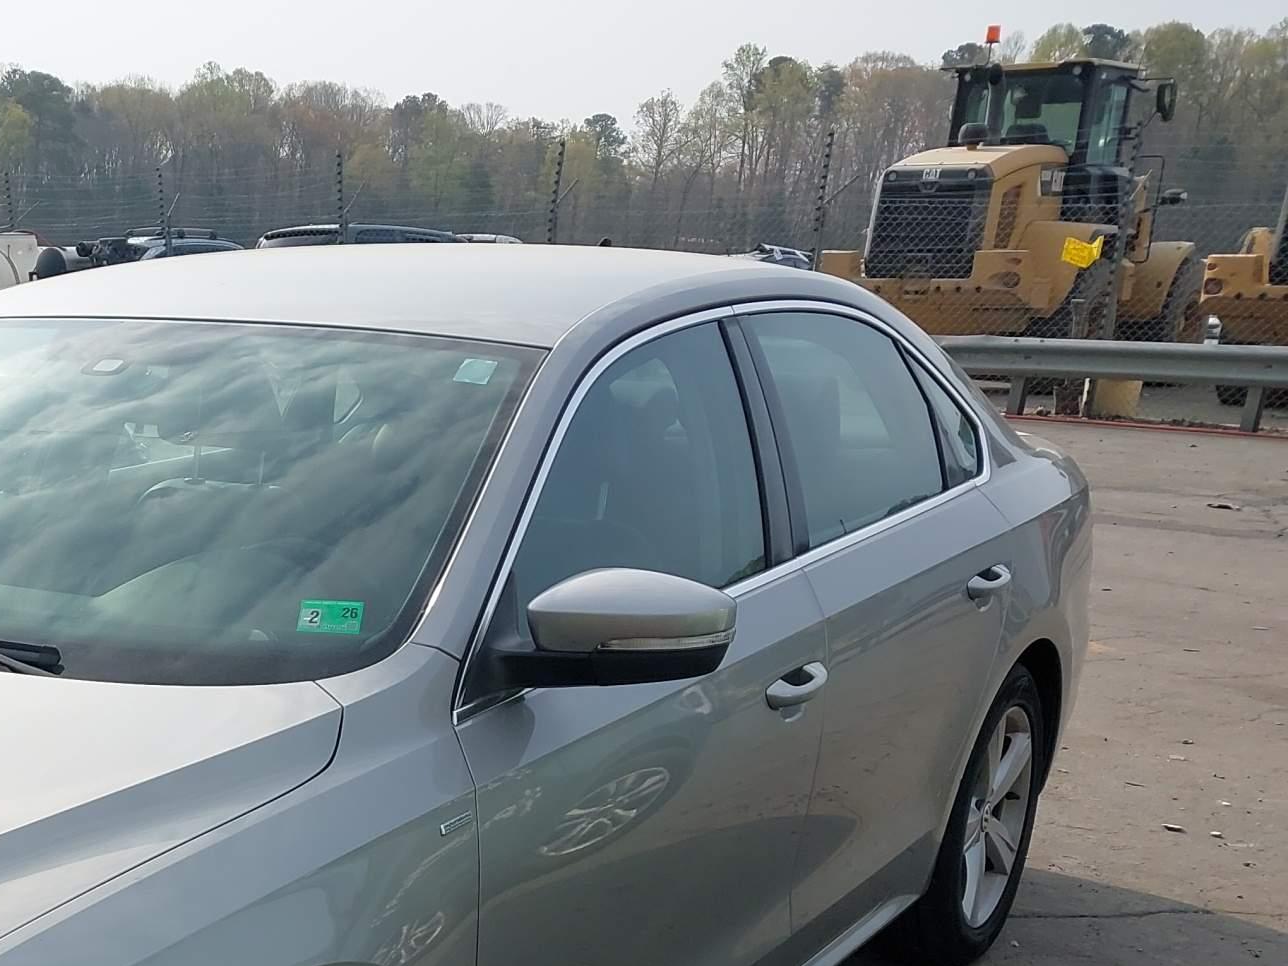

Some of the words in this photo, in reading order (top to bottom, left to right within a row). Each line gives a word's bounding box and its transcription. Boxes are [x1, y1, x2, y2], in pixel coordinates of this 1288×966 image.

[922, 168, 942, 180] CAT
[308, 610, 320, 624] 2
[342, 607, 359, 619] 26
